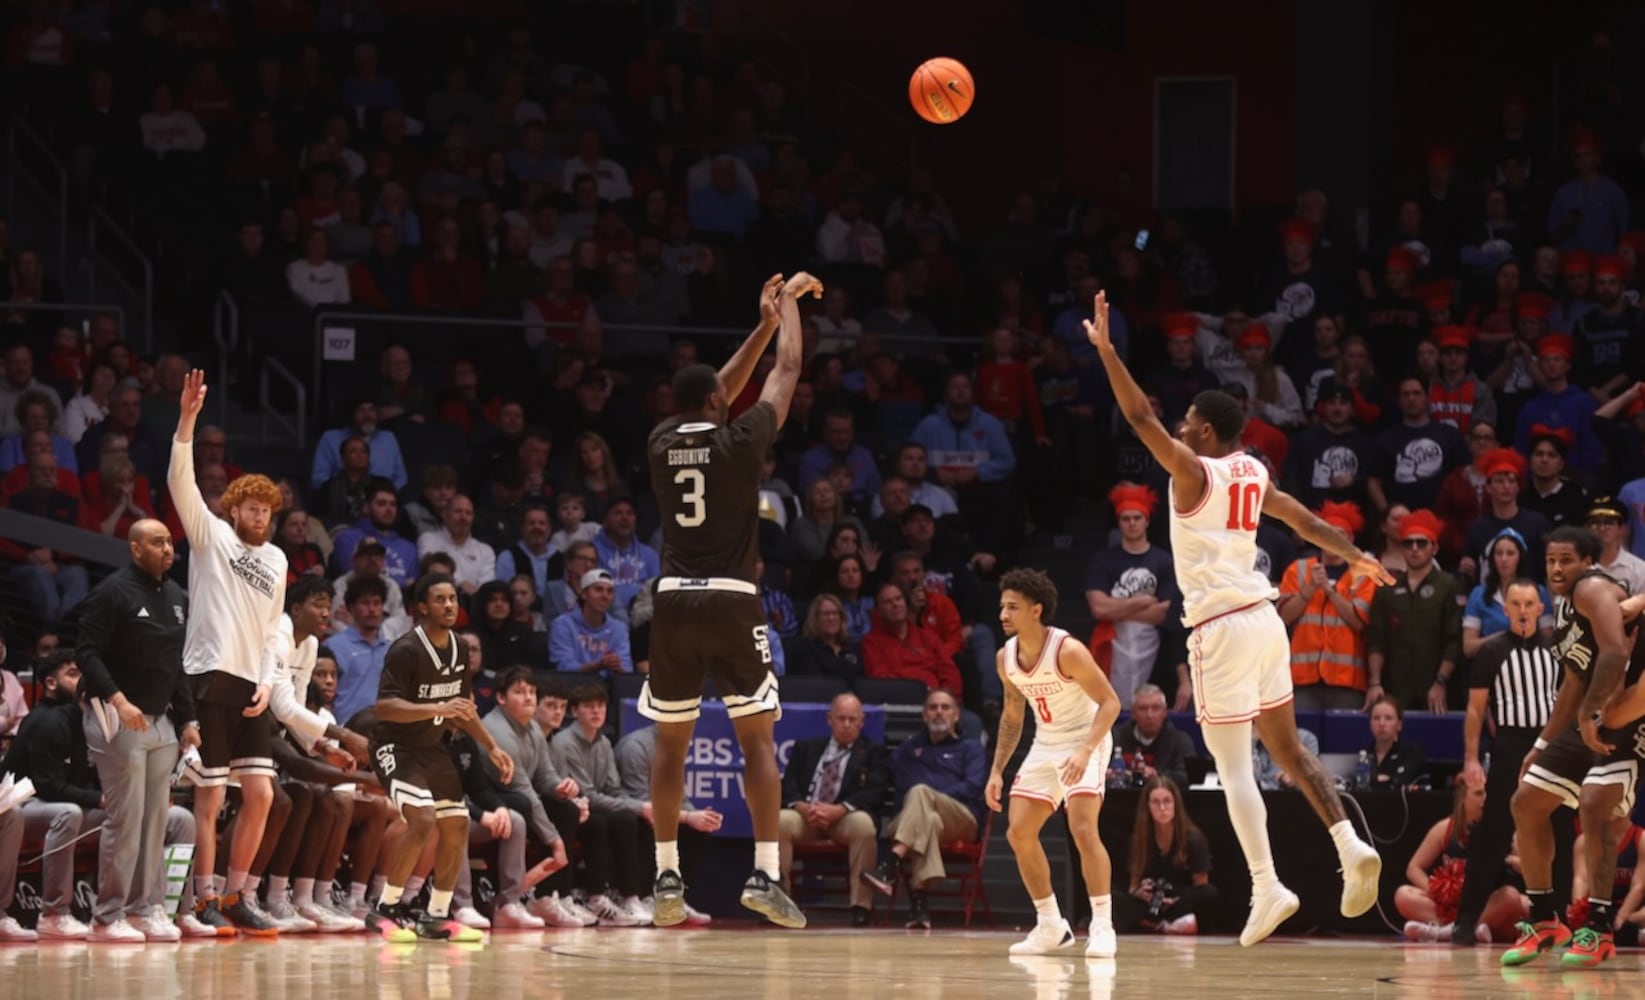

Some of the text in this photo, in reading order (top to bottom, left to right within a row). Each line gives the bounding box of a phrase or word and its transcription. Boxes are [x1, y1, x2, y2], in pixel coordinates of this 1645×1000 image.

[329, 338, 350, 350] 107
[673, 468, 706, 528] 3
[1226, 482, 1261, 532] 10
[1565, 642, 1593, 671] 00
[1016, 681, 1064, 697] AYTON
[1035, 696, 1053, 723] 0
